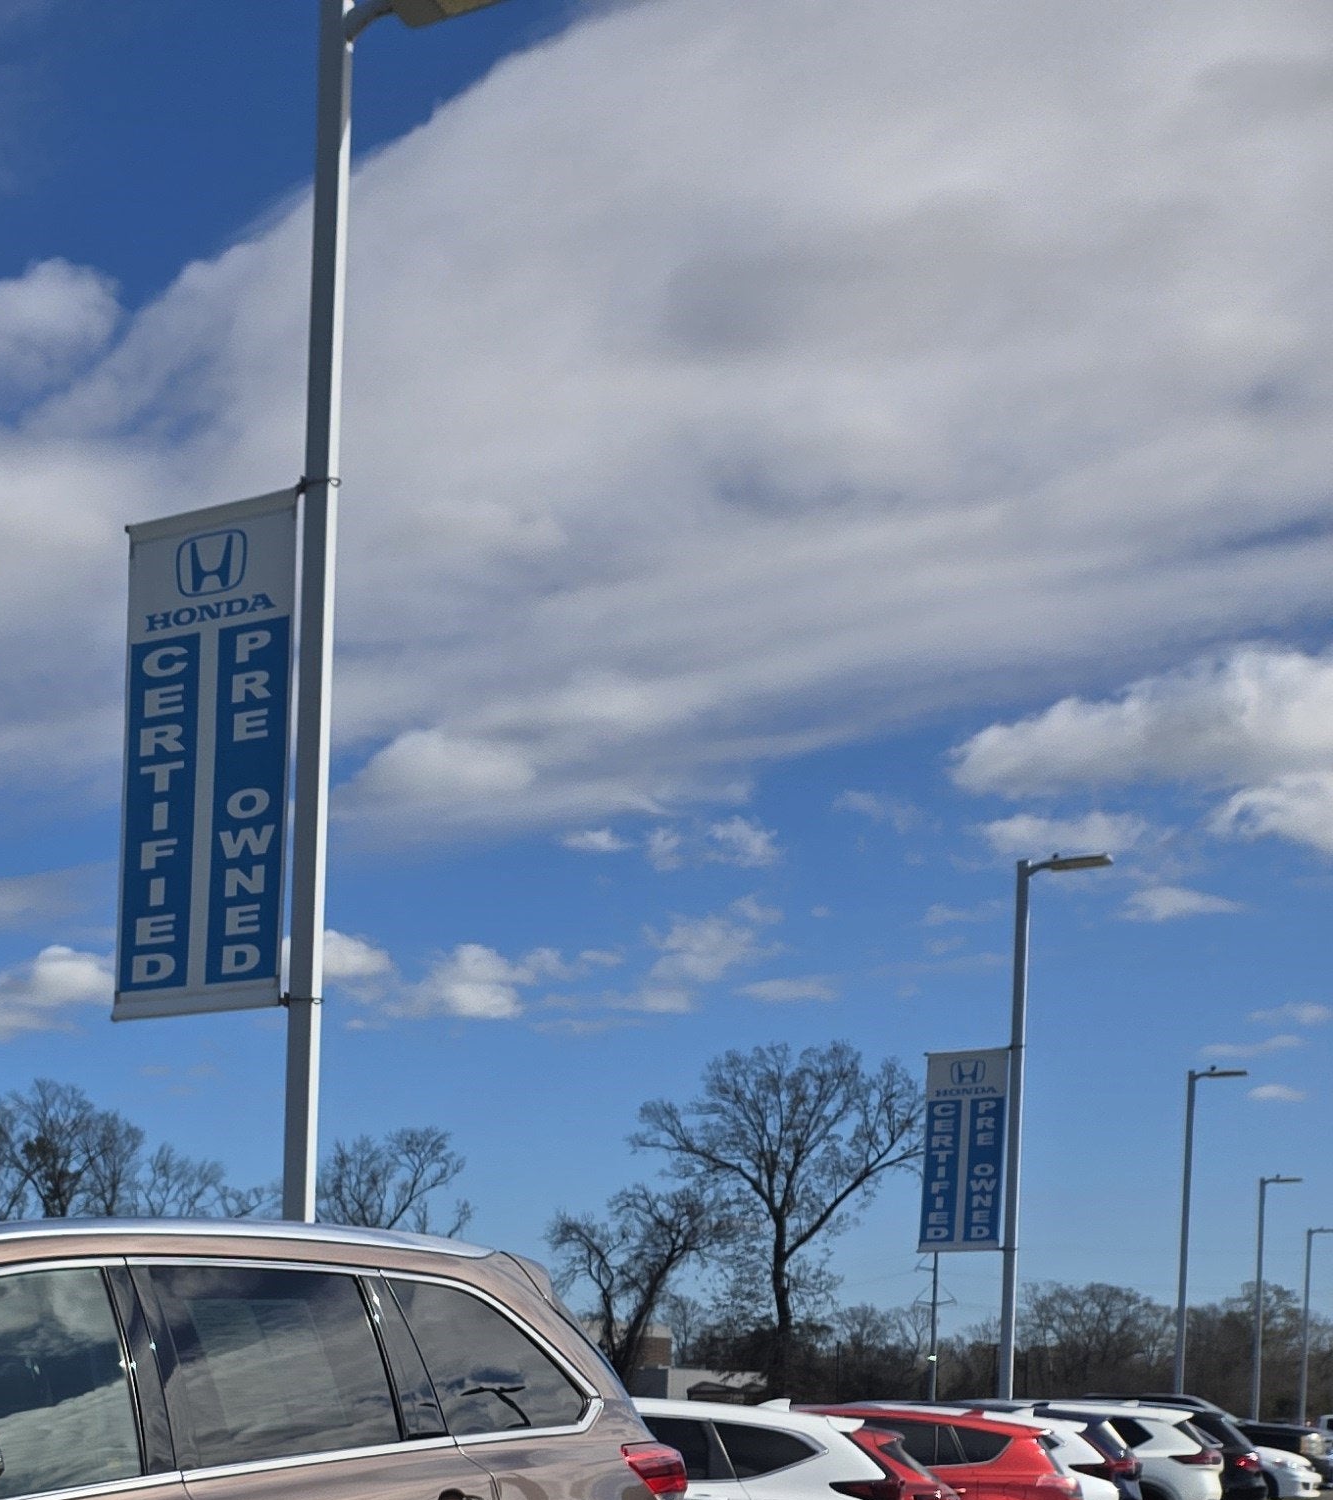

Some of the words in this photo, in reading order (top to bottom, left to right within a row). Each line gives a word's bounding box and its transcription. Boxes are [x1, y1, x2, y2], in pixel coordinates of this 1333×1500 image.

[144, 592, 276, 632] HONDA
[231, 629, 272, 743] PRE
[130, 644, 189, 984] CERTIFIED
[218, 786, 276, 976] OWNED
[934, 1086, 998, 1098] HONDA
[975, 1100, 998, 1146] PRE
[925, 1103, 957, 1240] CERTIFIED
[969, 1163, 997, 1239] OWNED
